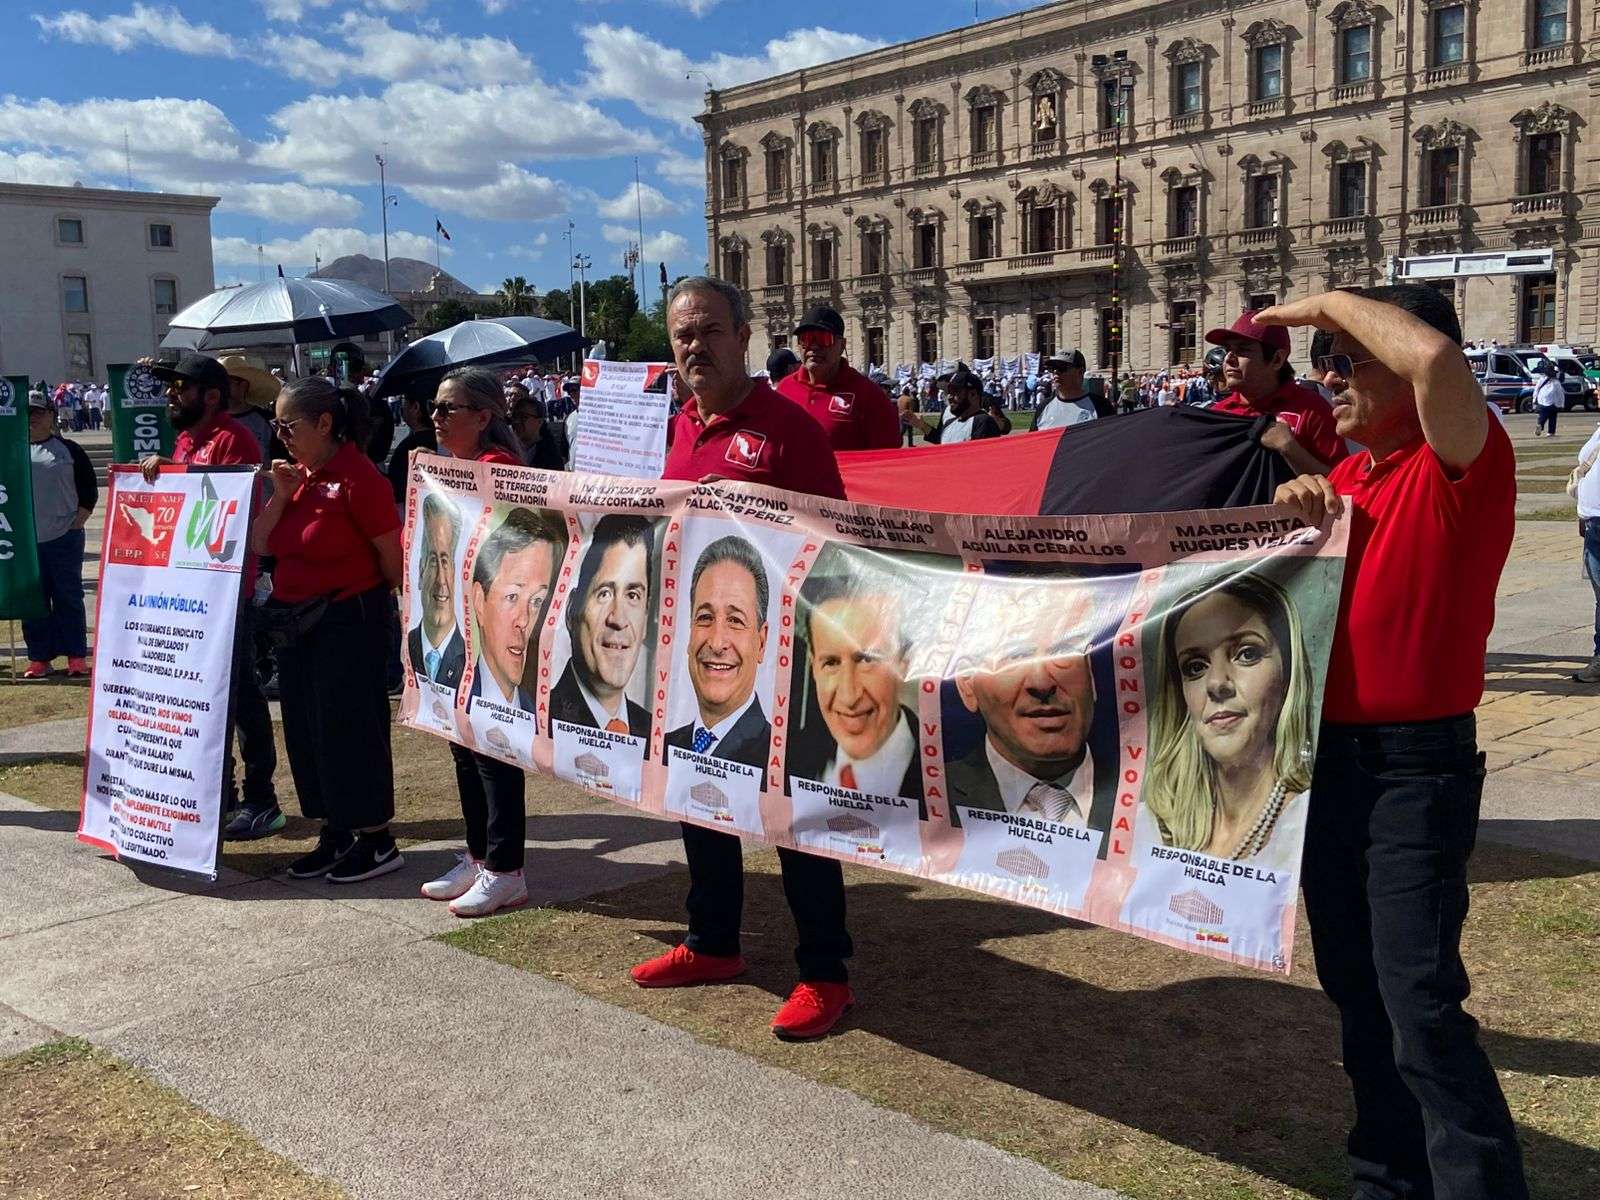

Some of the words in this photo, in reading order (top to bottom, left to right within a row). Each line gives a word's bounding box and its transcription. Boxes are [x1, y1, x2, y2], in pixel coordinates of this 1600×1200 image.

[438, 466, 475, 480] ANTONIO
[490, 467, 518, 479] PEDRO
[494, 479, 505, 490] DE
[506, 481, 548, 494] TERREROS
[723, 491, 788, 511] ANTONIO
[157, 507, 176, 523] 70
[820, 508, 877, 527] DIONISIO
[876, 517, 934, 535] HILARIO
[984, 527, 1089, 543] ALEJANDRO
[1175, 517, 1305, 538] MARGARITA
[463, 506, 492, 581] PATRONO
[886, 531, 927, 545] SILVA
[1169, 537, 1250, 553] HUGUES
[961, 540, 1031, 555] AGUILAR
[1032, 543, 1127, 557] CEBALLOS
[547, 516, 580, 627] PATRONO
[661, 521, 680, 645] PATRONO
[128, 594, 137, 606] A
[169, 593, 208, 614] PÚBLICA:
[779, 543, 817, 667] PATRONO
[124, 621, 139, 630] LOS
[172, 627, 204, 640] SINDICATO
[154, 639, 184, 652] EMPLEADOS
[184, 642, 189, 653] Y
[103, 683, 136, 696] QUEREMO
[155, 693, 166, 704] POR
[166, 696, 210, 712] VIOLACIONES
[538, 649, 551, 730] VOCAL
[115, 698, 121, 708] A
[157, 708, 171, 719] NOS
[171, 711, 192, 723] VIMOS
[475, 699, 517, 717] RESPONSABLE
[517, 709, 524, 718] DE
[524, 711, 532, 721] LA
[490, 711, 515, 725] HUELGA
[654, 670, 668, 756] VOCAL
[135, 730, 168, 746] EPRESENTA
[168, 738, 183, 750] QUE
[157, 722, 183, 736] HUELGA,
[184, 727, 200, 738] AUN
[557, 723, 614, 741] RESPONSABLE
[614, 735, 626, 745] DE
[627, 737, 639, 747] LA
[579, 736, 612, 751] HUELGA
[769, 695, 786, 788] VOCAL
[105, 748, 128, 760] DURANT
[143, 761, 158, 773] DURE
[159, 766, 168, 775] LA
[168, 767, 195, 781] MISMA,
[147, 748, 174, 761] SALARIO
[673, 749, 730, 771] RESPONSABLE
[730, 763, 742, 775] DE
[742, 766, 755, 778] LA
[695, 764, 728, 780] HUELGA
[923, 723, 944, 819] VOCAL
[96, 784, 109, 796] NOS
[161, 808, 201, 823] EXIGIMOS
[145, 791, 159, 801] MAS
[160, 794, 170, 804] DE
[170, 796, 179, 806] LO
[180, 799, 198, 810] QUE
[798, 780, 874, 803] RESPONSABLE
[874, 796, 891, 807] DE
[892, 798, 909, 809] LA
[828, 797, 875, 812] HUELGA
[1112, 745, 1143, 856] VOCAL
[139, 816, 146, 826] SE
[147, 819, 172, 833] MUTILE
[967, 809, 1058, 836] RESPONSABLE
[1058, 826, 1074, 839] DE
[1075, 830, 1091, 843] LA
[134, 829, 174, 847] COLECTIVO
[1008, 827, 1054, 846] HUELGA
[125, 841, 168, 860] LEGITIMADO.
[1150, 847, 1231, 875] RESPONSABLE
[1232, 864, 1255, 880] DE
[1255, 869, 1277, 884] LA
[1184, 865, 1227, 887] HUELGA
